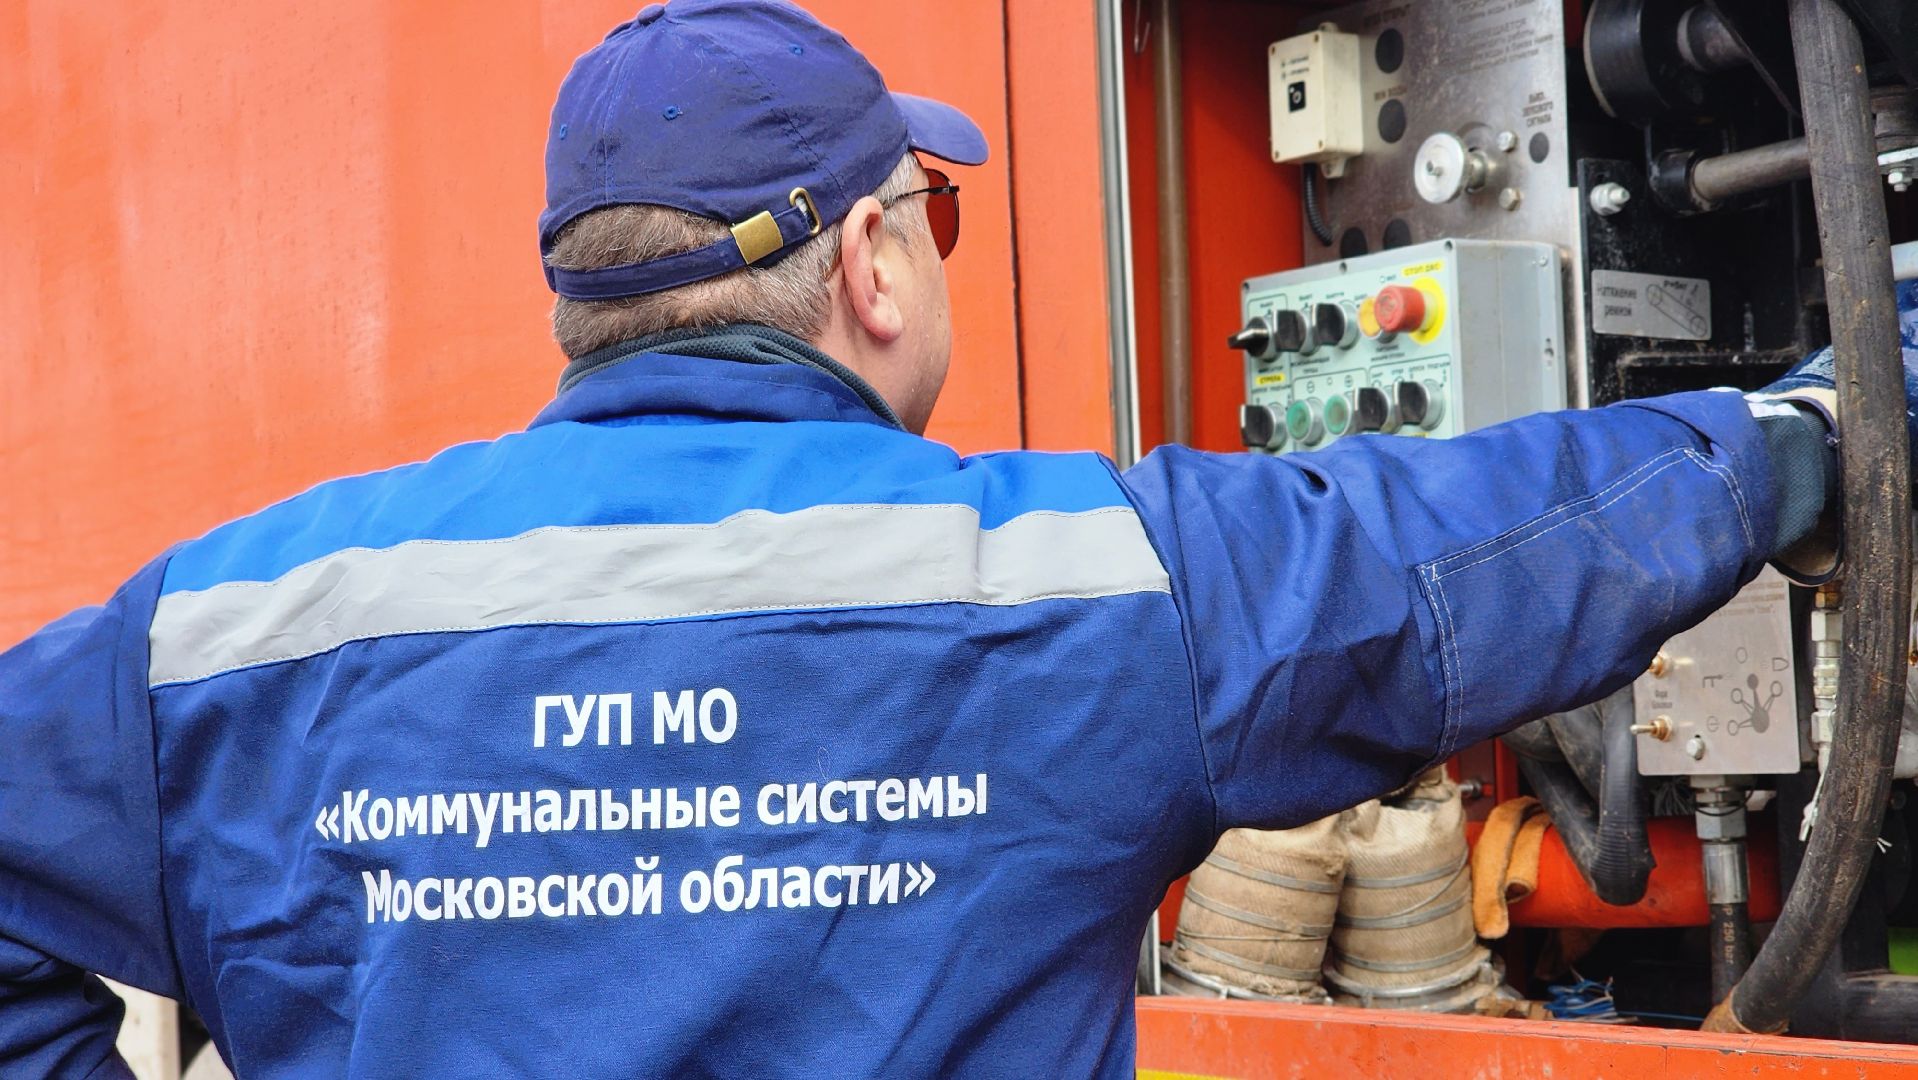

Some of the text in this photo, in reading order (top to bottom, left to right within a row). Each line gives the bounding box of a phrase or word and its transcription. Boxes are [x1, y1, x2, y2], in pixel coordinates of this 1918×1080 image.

[533, 687, 738, 748] ГУП МО
[315, 773, 987, 848] «Коммунальные системы
[361, 854, 936, 924] Московской области»
[1722, 921, 1736, 942] 250
